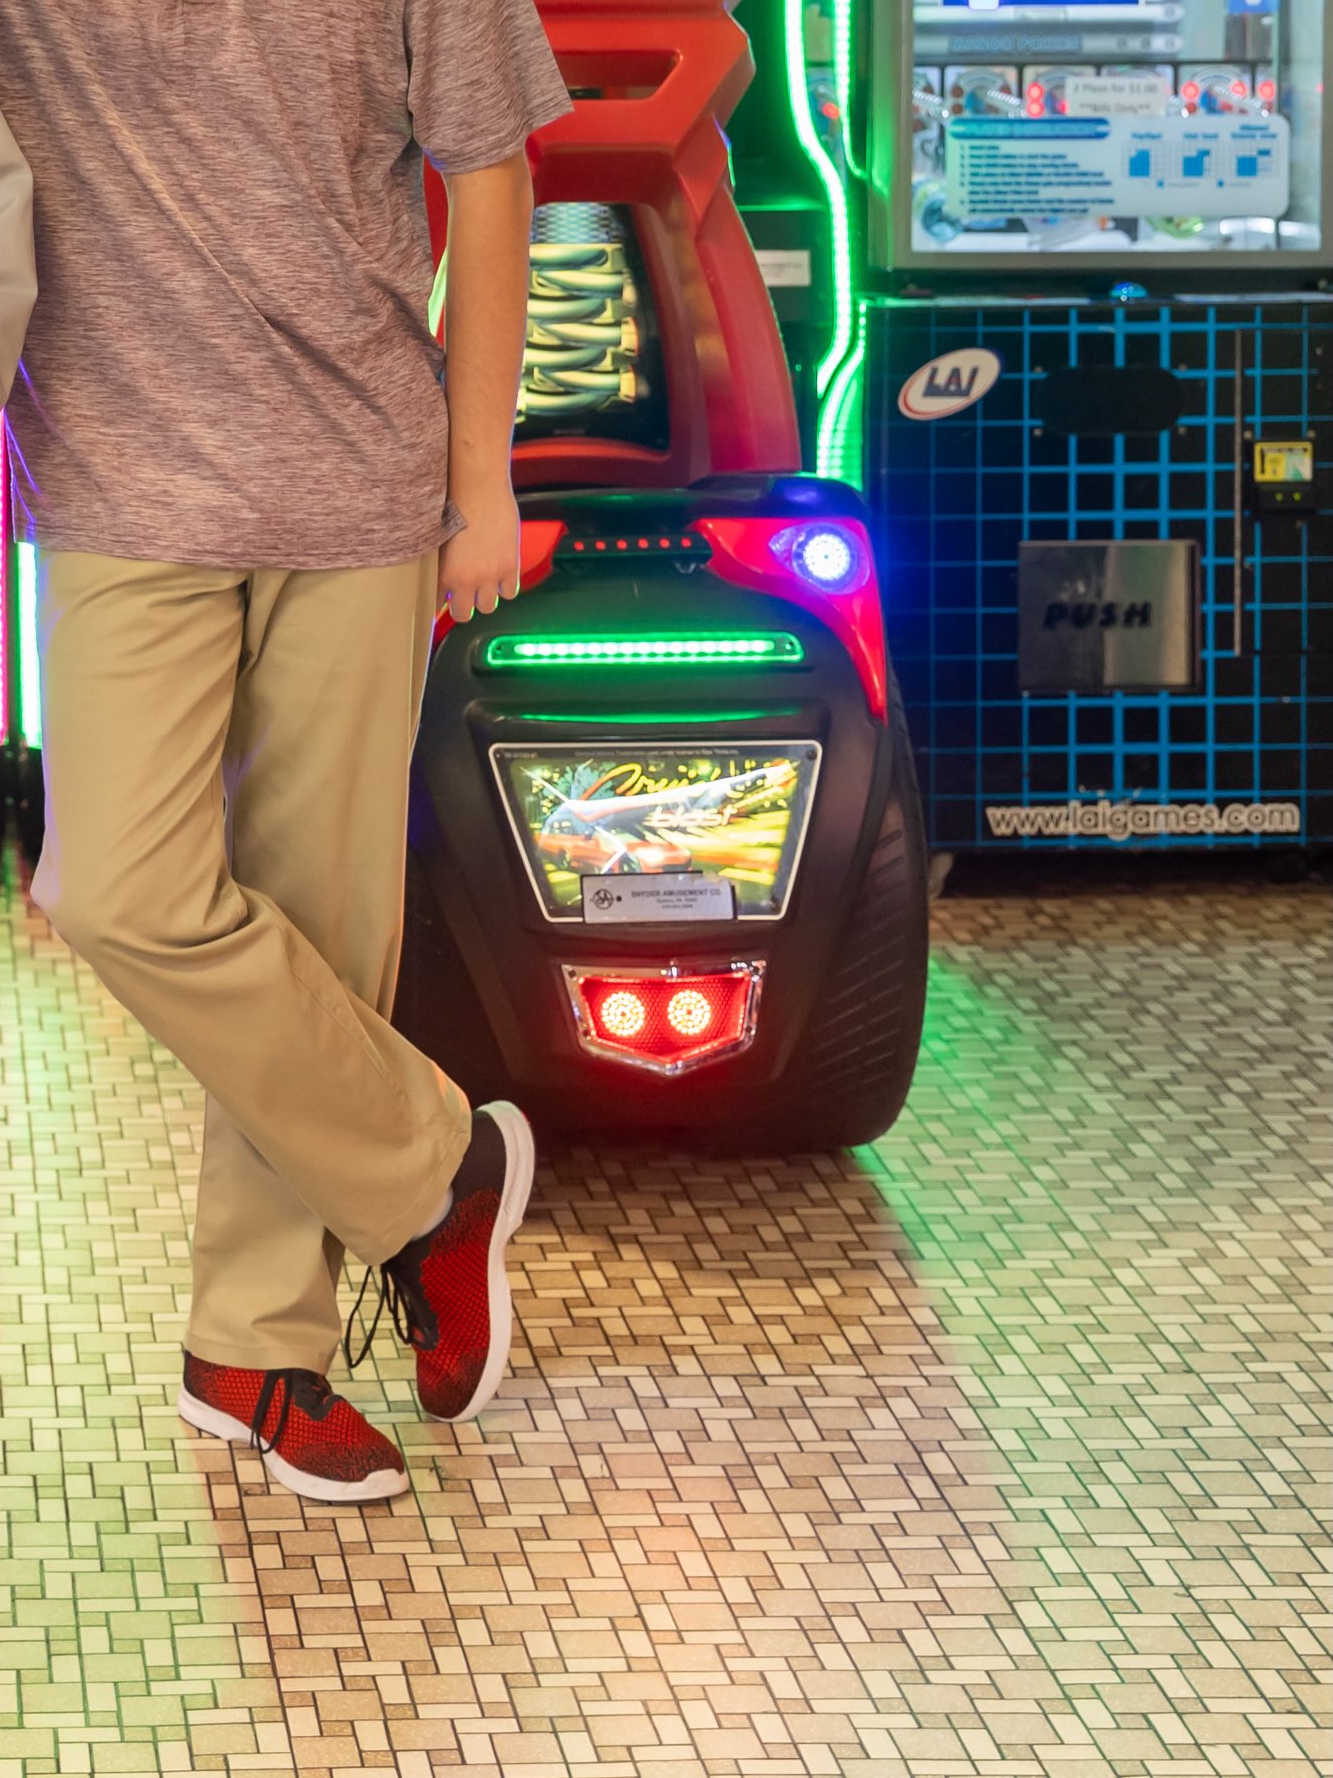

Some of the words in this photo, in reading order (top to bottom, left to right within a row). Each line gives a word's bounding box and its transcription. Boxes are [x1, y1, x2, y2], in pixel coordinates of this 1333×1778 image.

[921, 366, 979, 398] LAI
[1042, 601, 1152, 630] PUSH
[644, 805, 737, 827] blast
[985, 799, 1301, 842] www.laigames.com
